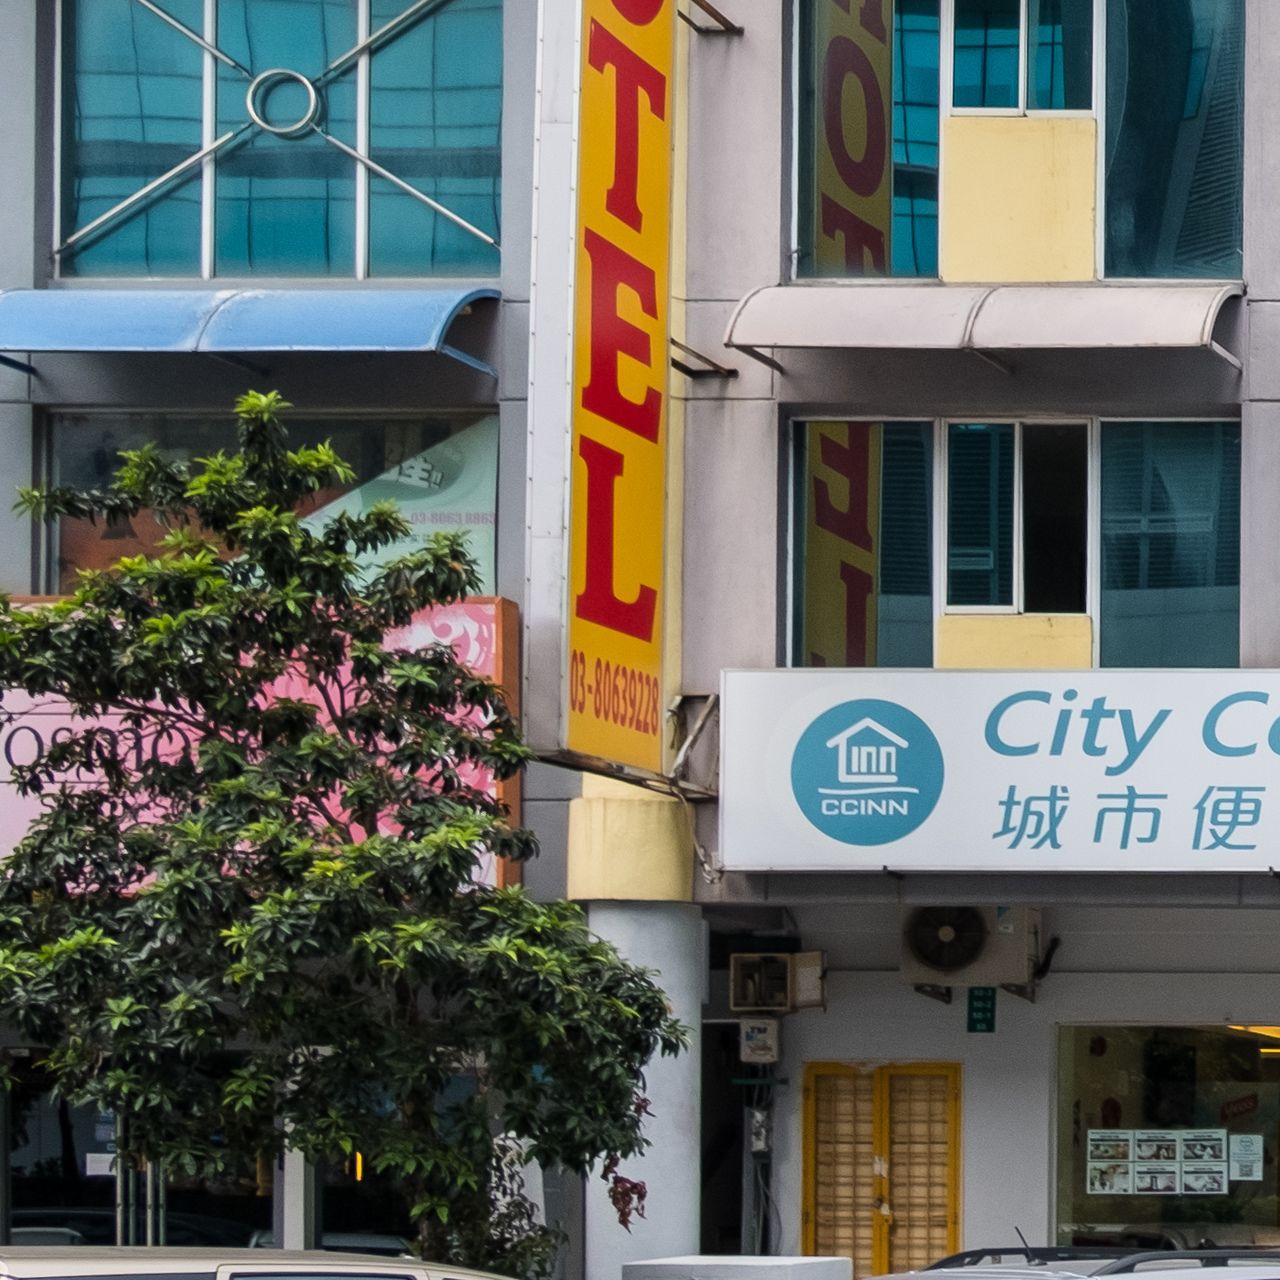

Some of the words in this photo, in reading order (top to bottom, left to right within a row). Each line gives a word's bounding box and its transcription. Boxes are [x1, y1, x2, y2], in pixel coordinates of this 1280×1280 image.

[570, 648, 660, 737] 03-80639228
[984, 688, 1173, 777] City
[821, 799, 909, 816] CCINN
